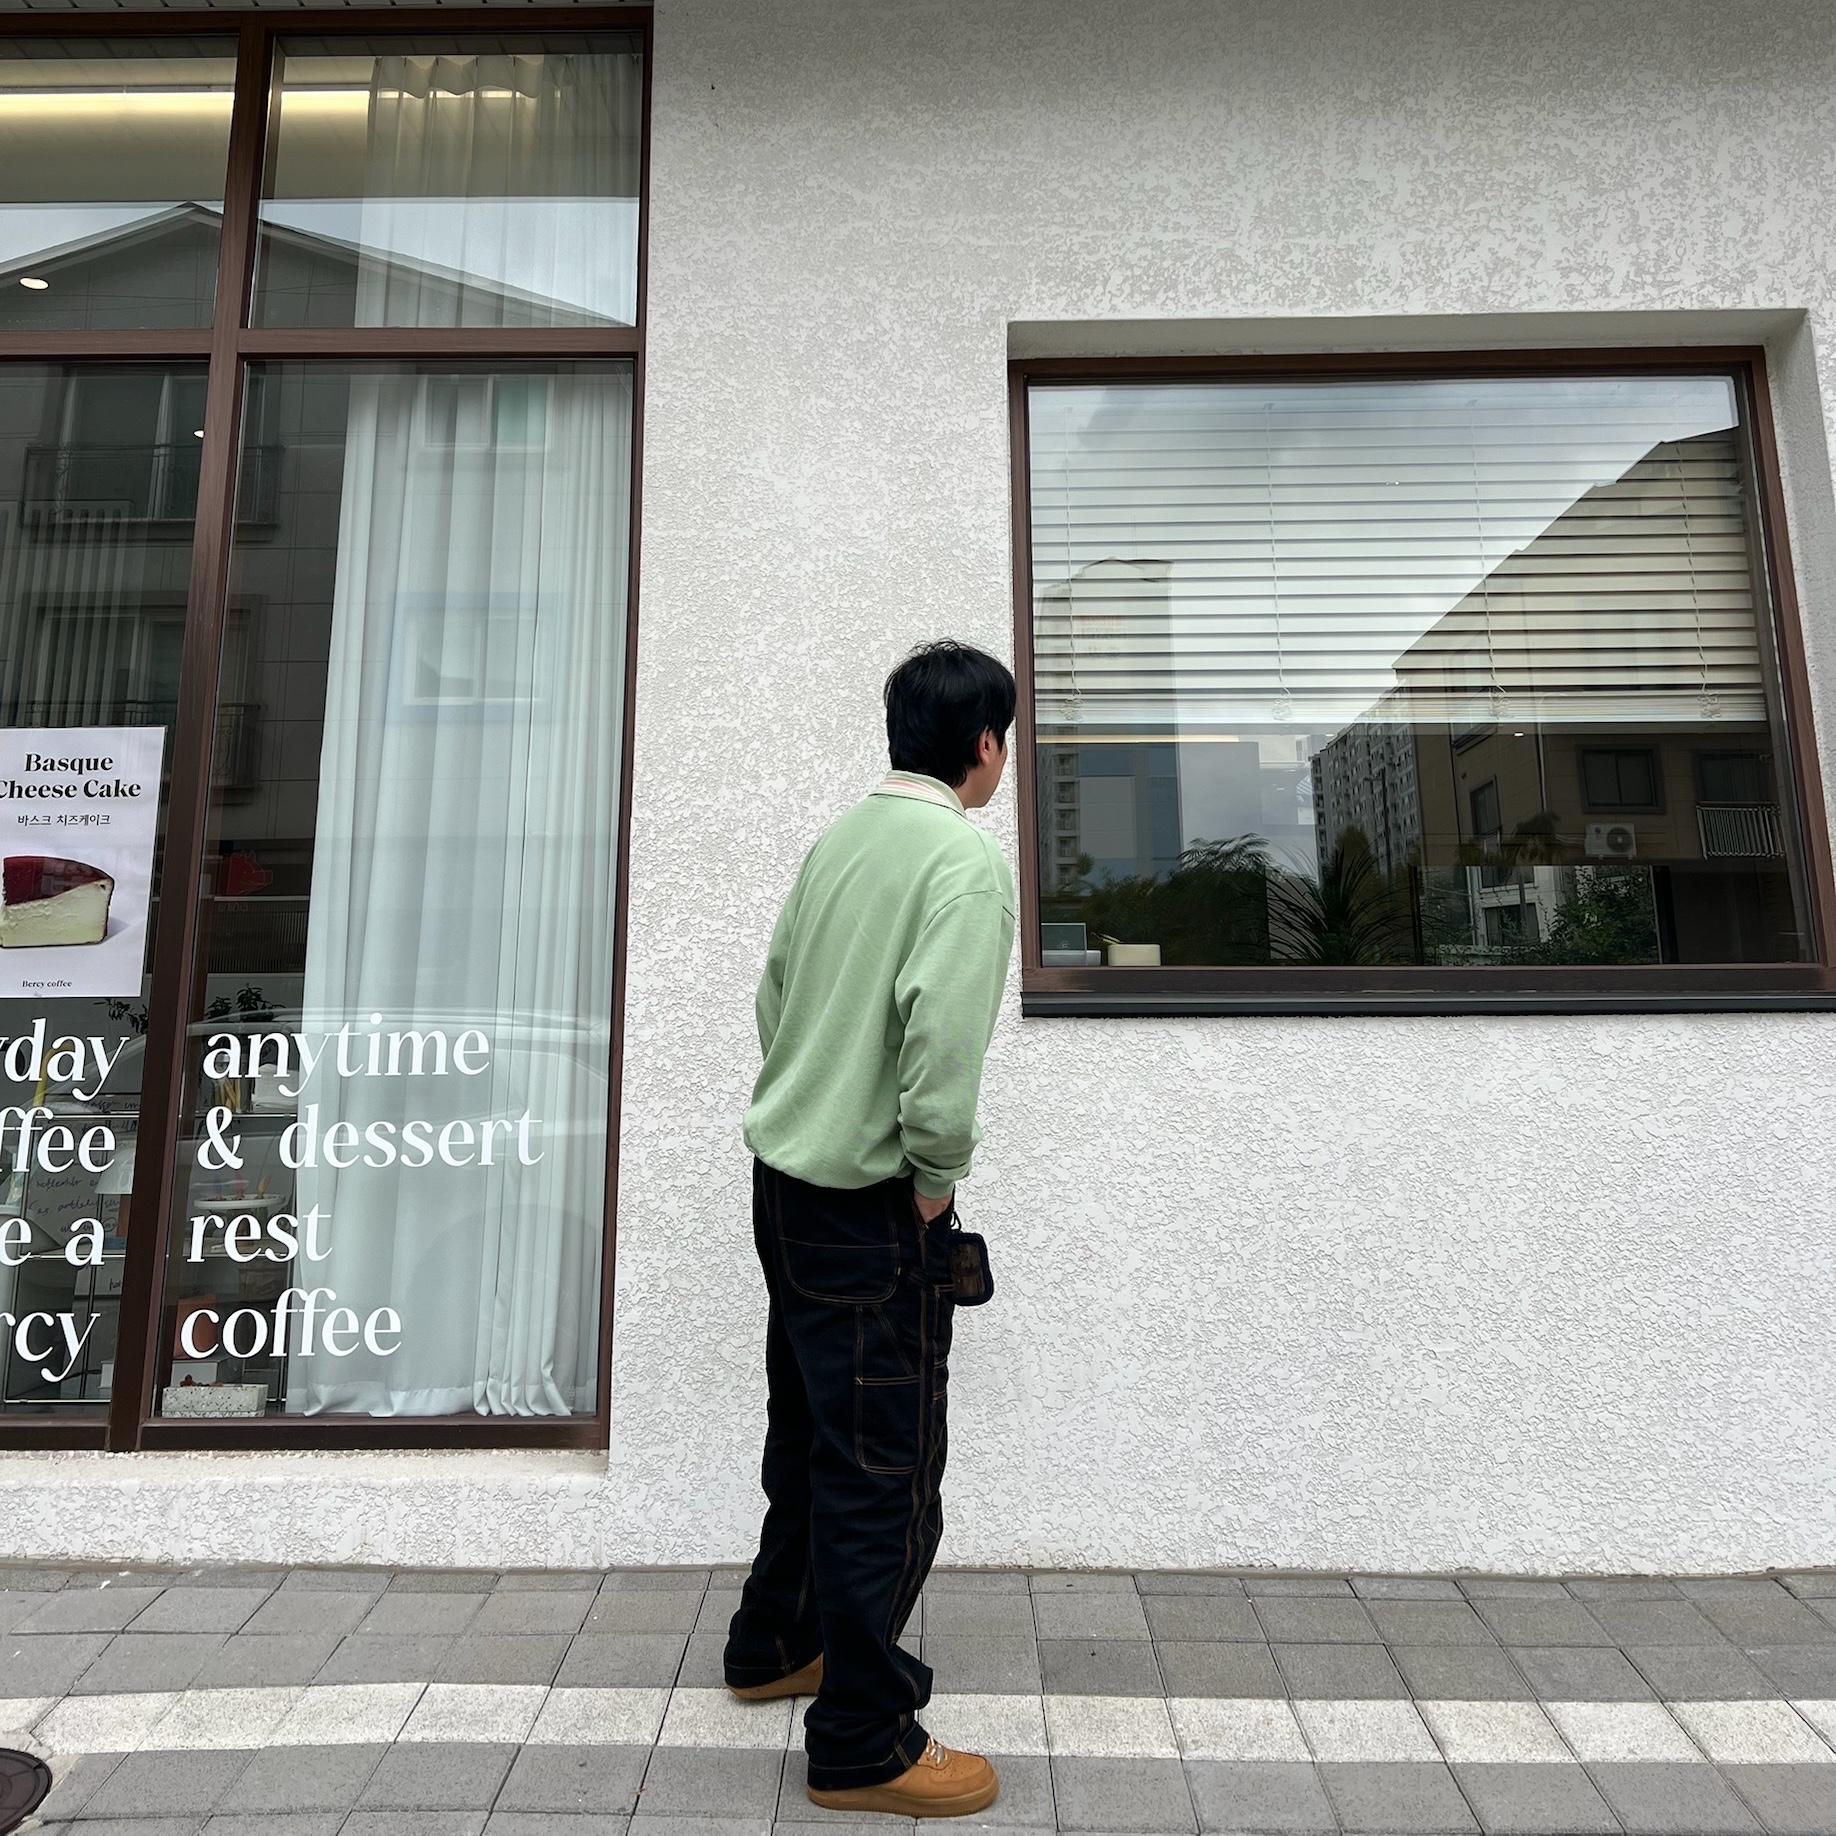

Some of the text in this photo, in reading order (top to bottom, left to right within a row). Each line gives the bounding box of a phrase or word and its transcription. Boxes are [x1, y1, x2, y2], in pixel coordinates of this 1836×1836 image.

[25, 754, 113, 775] Basque
[83, 780, 141, 797] Cake
[18, 814, 111, 826] 바스크 치즈케이크
[22, 979, 72, 989] Bercy coffee
[0, 1014, 489, 1100] day anytime
[197, 1106, 243, 1169] &
[279, 1104, 545, 1167] dessert
[66, 1217, 105, 1266] a
[187, 1204, 333, 1262] rest
[181, 1289, 401, 1358] coffee
